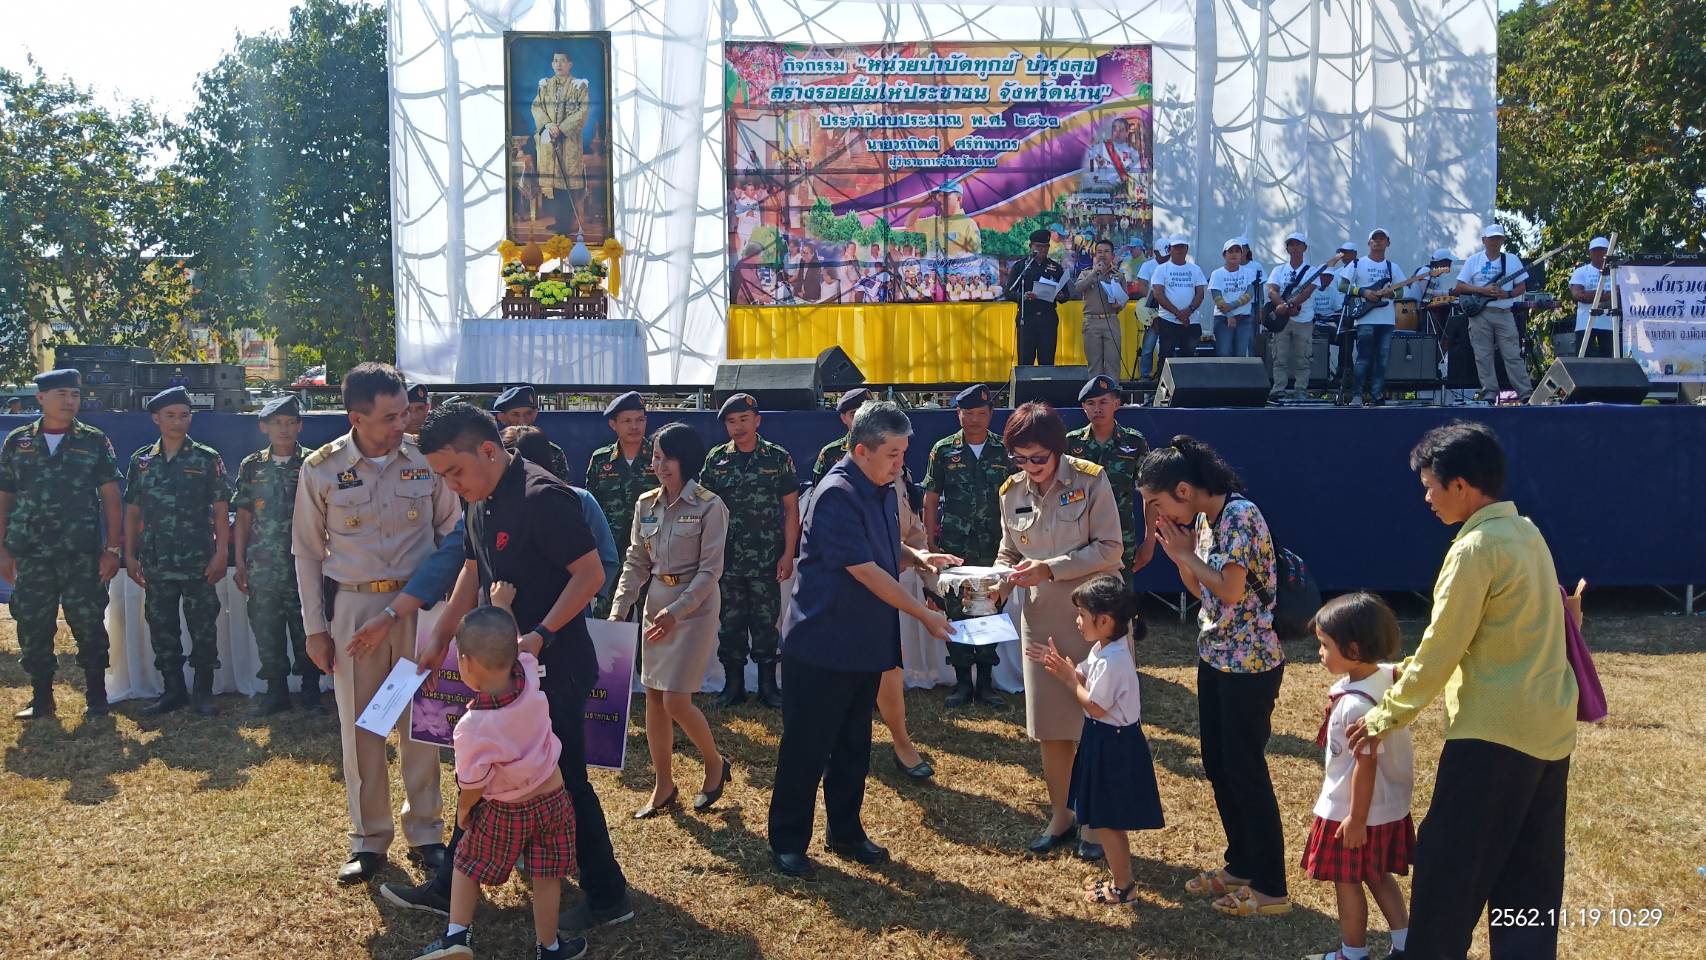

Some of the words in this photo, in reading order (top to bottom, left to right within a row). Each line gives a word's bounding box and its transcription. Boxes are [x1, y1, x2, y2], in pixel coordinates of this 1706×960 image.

[782, 57, 847, 74] กิจกรรม
[1025, 54, 1097, 78] บำรุงสุข
[819, 112, 963, 127] ประจำปีงบประมาณ
[970, 114, 1006, 127] พ.ศ.
